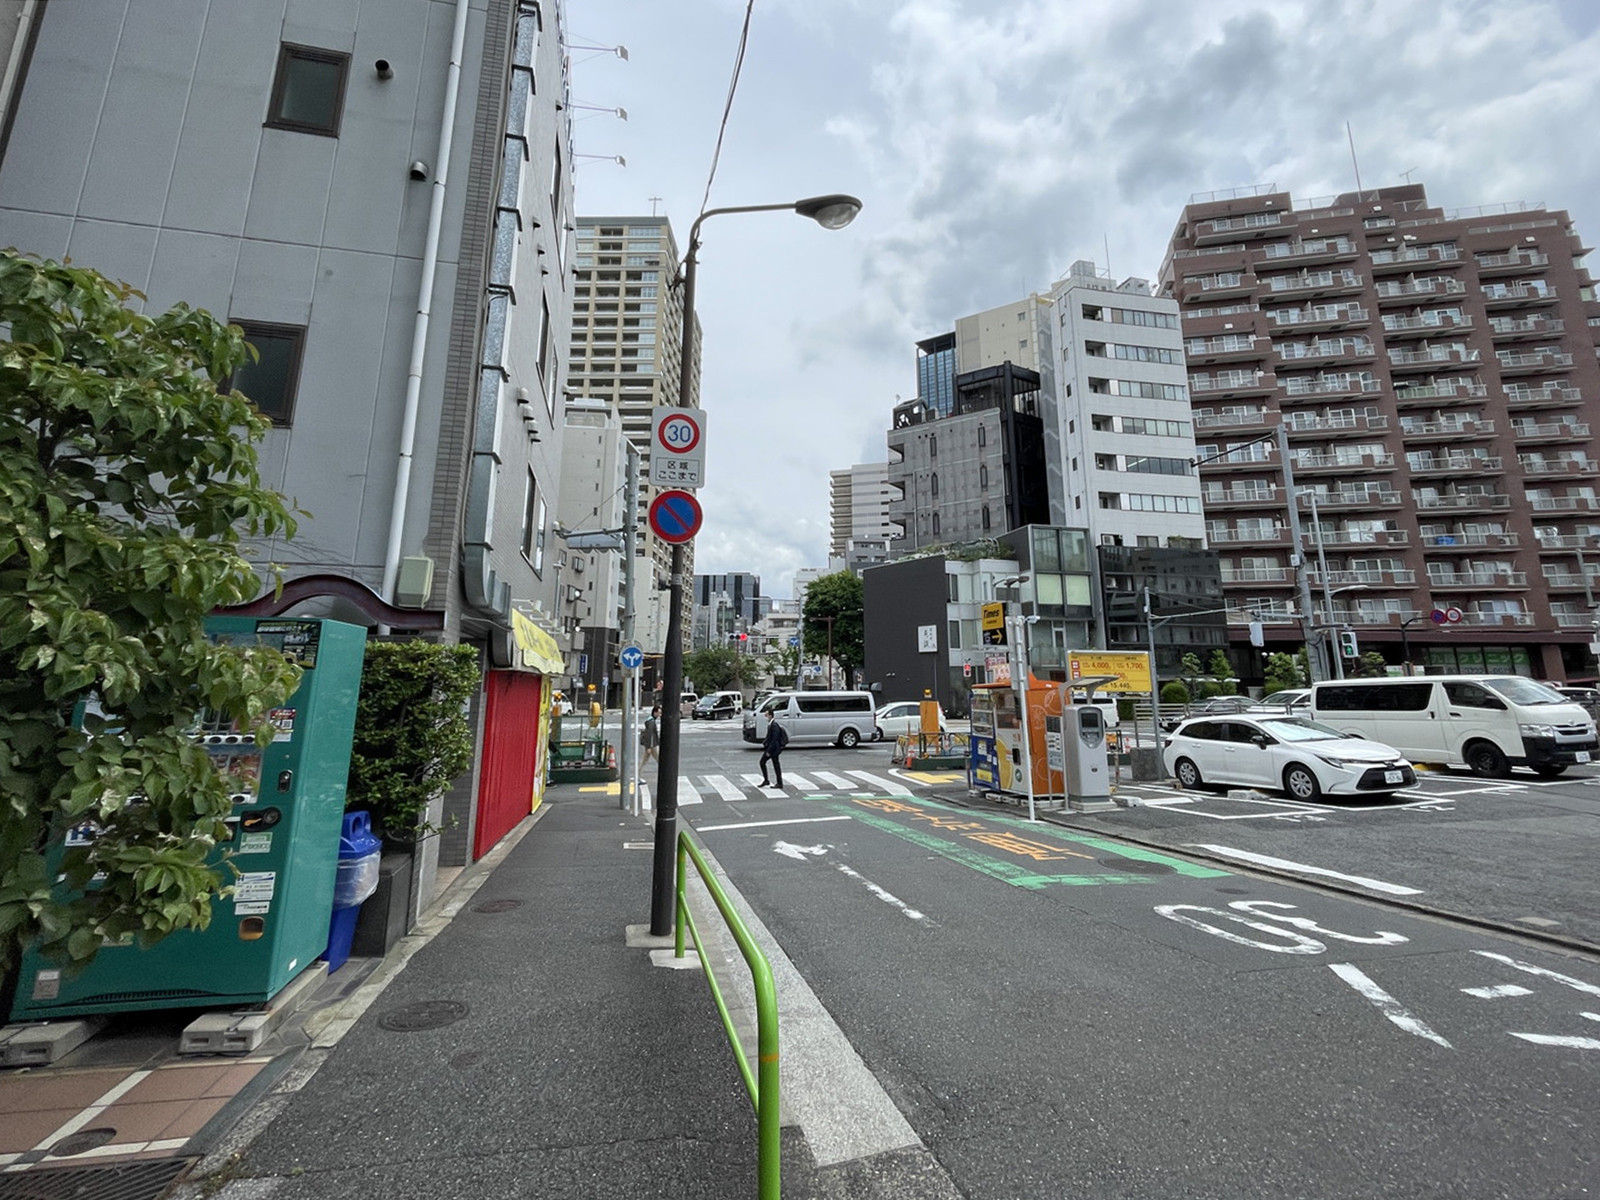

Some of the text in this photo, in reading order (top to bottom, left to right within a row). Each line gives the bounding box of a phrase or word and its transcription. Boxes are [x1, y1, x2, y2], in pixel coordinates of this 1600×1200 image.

[668, 424, 692, 443] 30
[667, 460, 689, 470] 区域
[658, 470, 697, 481] ここまで
